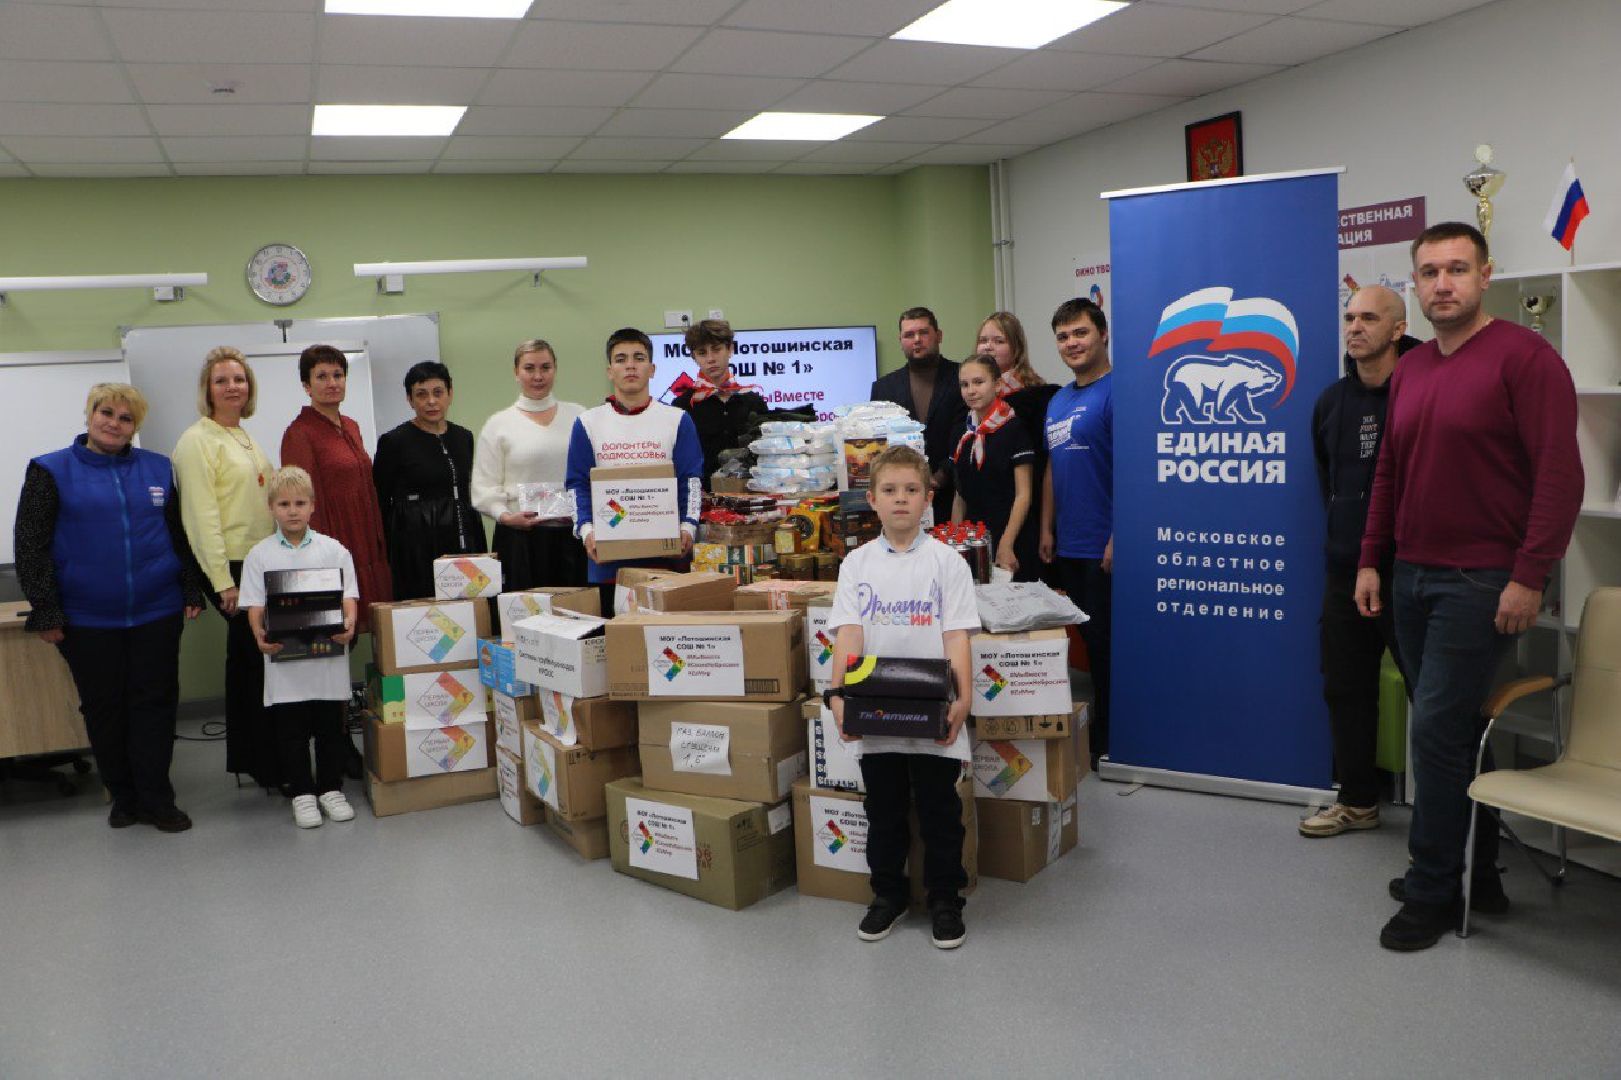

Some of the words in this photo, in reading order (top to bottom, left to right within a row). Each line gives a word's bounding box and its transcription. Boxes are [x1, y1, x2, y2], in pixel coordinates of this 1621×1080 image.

[1338, 205, 1413, 227] СТВЕННАЯ
[1338, 229, 1372, 245] АЦИЯ
[727, 361, 757, 377] ОШ
[763, 361, 786, 375] №
[1157, 432, 1286, 456] ЕДИНАЯ
[1157, 459, 1286, 484] РОССИЯ
[1157, 526, 1285, 546] Московское
[1157, 552, 1285, 572] областное
[1157, 577, 1285, 596] региональное
[1157, 601, 1284, 621] отделение
